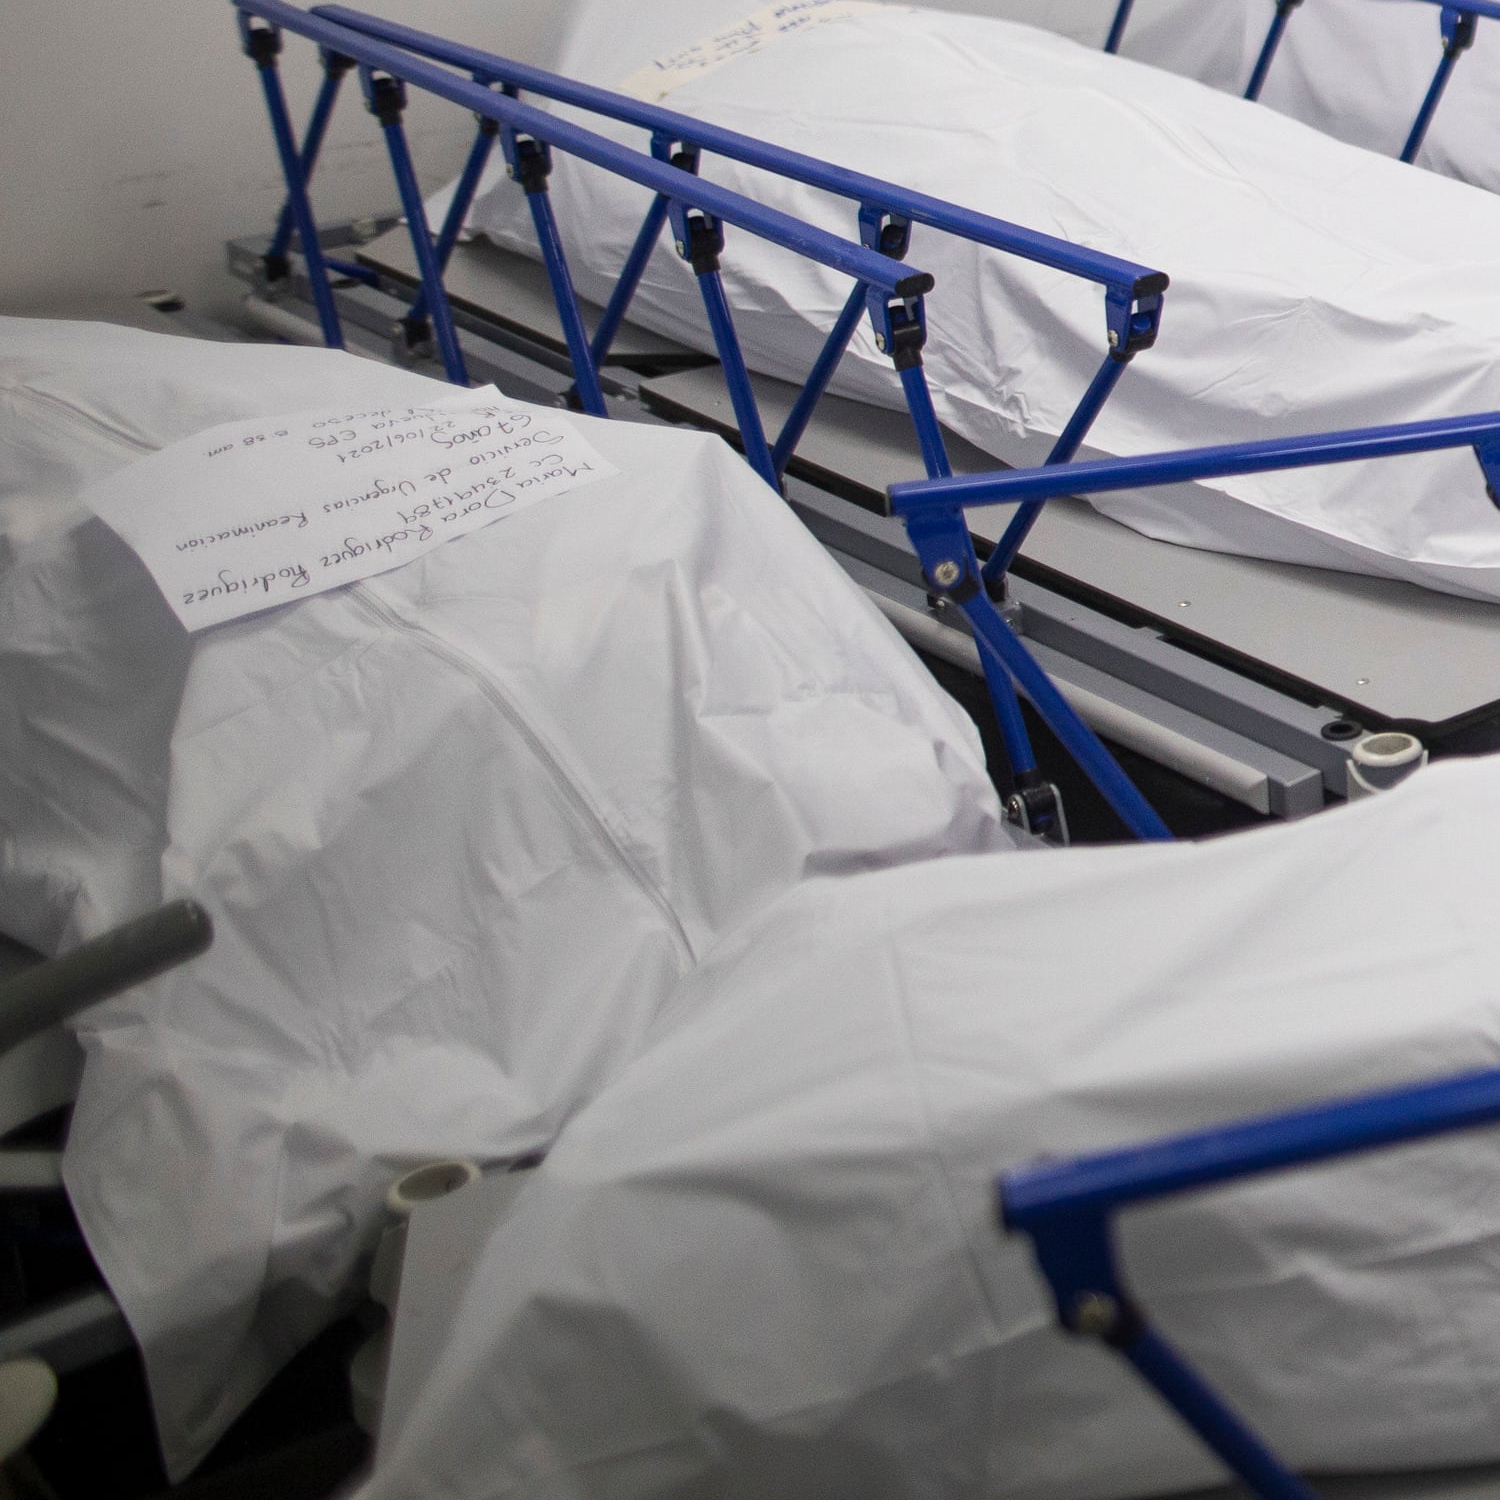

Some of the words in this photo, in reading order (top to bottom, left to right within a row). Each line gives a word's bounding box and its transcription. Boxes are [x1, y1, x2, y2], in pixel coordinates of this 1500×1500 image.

[469, 430, 564, 465] Servicio
[424, 467, 452, 484] de
[323, 479, 416, 514] Urgencias
[320, 524, 433, 567] Rodriguez
[182, 564, 311, 605] Rodriguez
